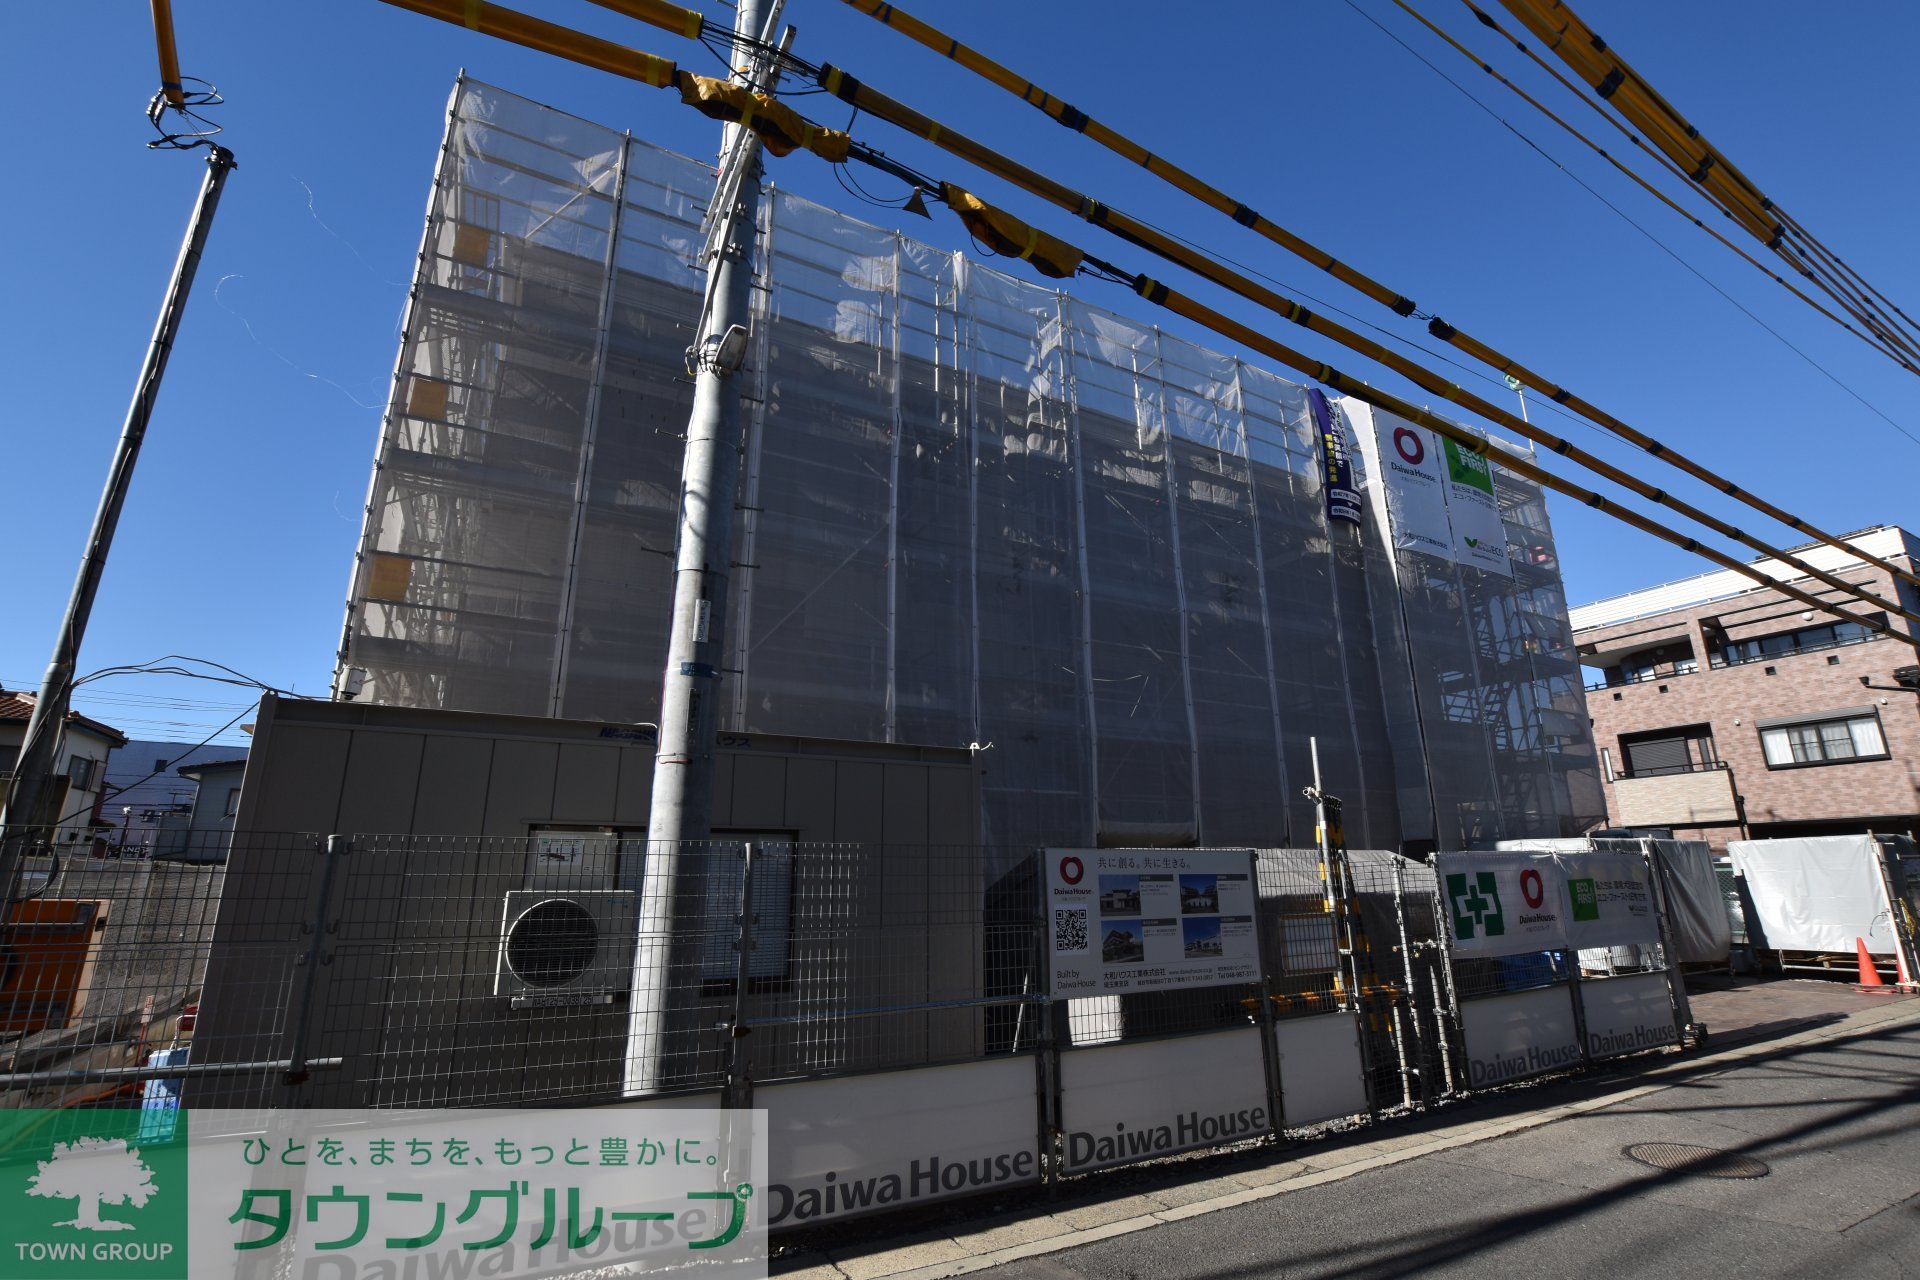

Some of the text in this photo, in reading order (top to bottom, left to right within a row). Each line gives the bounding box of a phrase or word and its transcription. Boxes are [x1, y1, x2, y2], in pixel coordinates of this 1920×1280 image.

[1460, 453, 1487, 476] FIRST
[1098, 856, 1191, 869] 共に創る。共に生きる。
[1576, 882, 1588, 892] ECO
[1578, 893, 1595, 904] FIRST
[1057, 970, 1080, 979] Built by
[1104, 968, 1166, 980] 大和ハウス工業株式会社
[1590, 1023, 1675, 1055] Daiwa House
[1471, 1043, 1578, 1084] Daiwa House
[1068, 1107, 1266, 1167] Daiwa House
[757, 1150, 1033, 1225] Daiwa House
